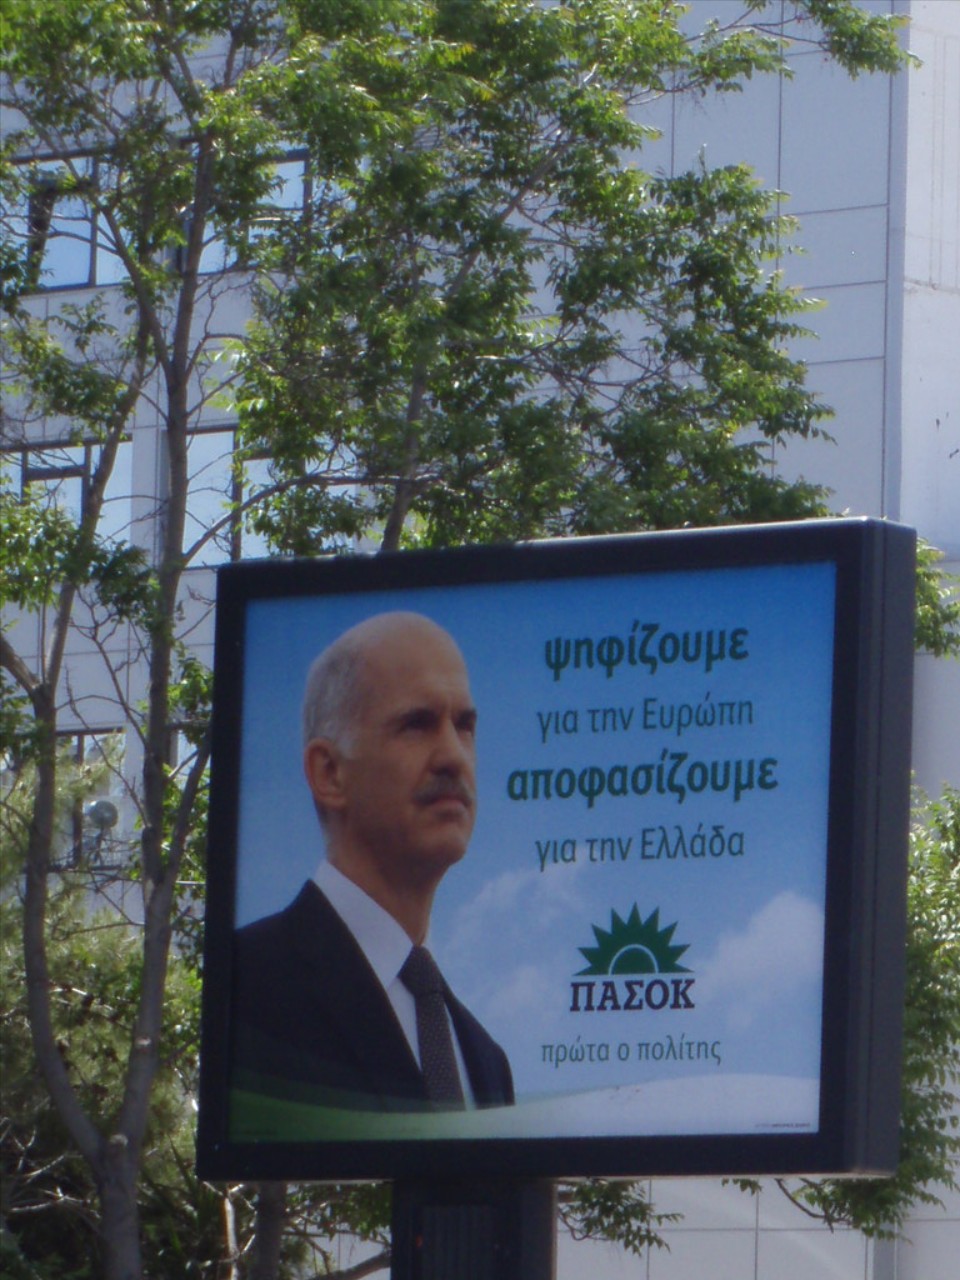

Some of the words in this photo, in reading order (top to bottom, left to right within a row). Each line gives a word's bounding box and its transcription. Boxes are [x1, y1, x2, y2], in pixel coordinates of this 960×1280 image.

[544, 619, 750, 682] ψηφίζουμε
[537, 709, 579, 743] για
[587, 707, 634, 732] την
[642, 691, 754, 736] Ευρώπη
[507, 748, 779, 808] αποφασίζουμε
[535, 838, 576, 872] για
[585, 836, 632, 862] την
[640, 822, 745, 860] Ελλάδα
[569, 979, 696, 1012] ΠΑΣΟΚ
[541, 1036, 610, 1068] πρώτα
[637, 1033, 722, 1065] πολίτης
